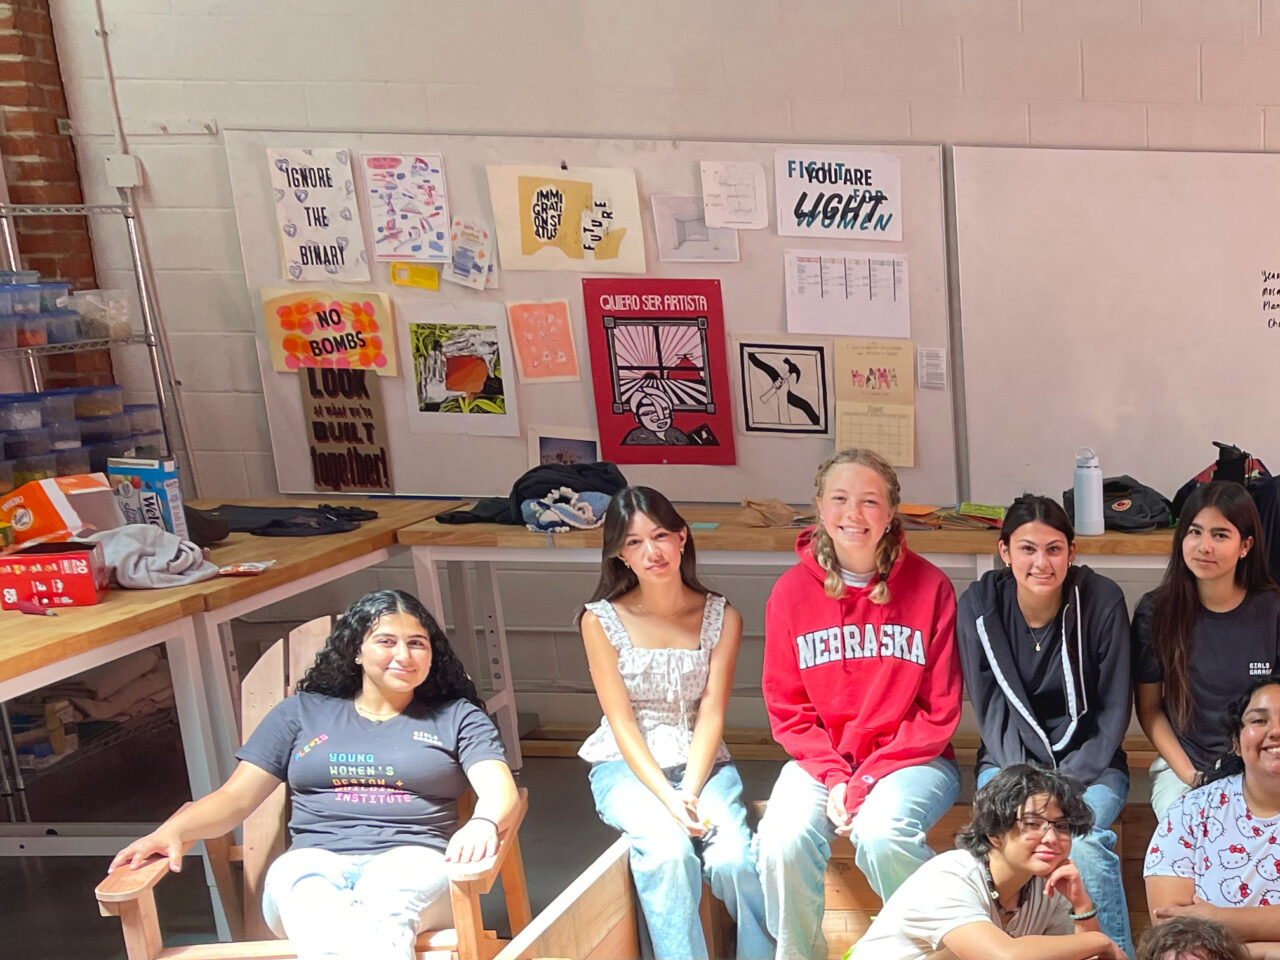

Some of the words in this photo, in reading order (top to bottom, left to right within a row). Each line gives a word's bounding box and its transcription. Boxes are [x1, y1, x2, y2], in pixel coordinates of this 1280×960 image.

[285, 167, 334, 189] IGNORE
[805, 166, 838, 184] YOU
[843, 168, 873, 186] ARE
[304, 206, 329, 227] THE
[794, 191, 889, 223] LIGHT
[299, 245, 346, 266] BINARY
[599, 294, 640, 312] QUIERO
[641, 295, 664, 311] SER
[664, 295, 708, 312] ARTISTA
[316, 308, 342, 328] NO
[309, 331, 367, 357] BOMBS
[306, 367, 371, 399] LOOK
[312, 421, 376, 445] BUILT
[143, 495, 164, 528] Welc
[796, 623, 926, 669] NEBRASKA
[329, 752, 375, 763] YOUNG
[329, 766, 394, 776] WOMEN'S
[335, 793, 412, 805] INSTITUTE
